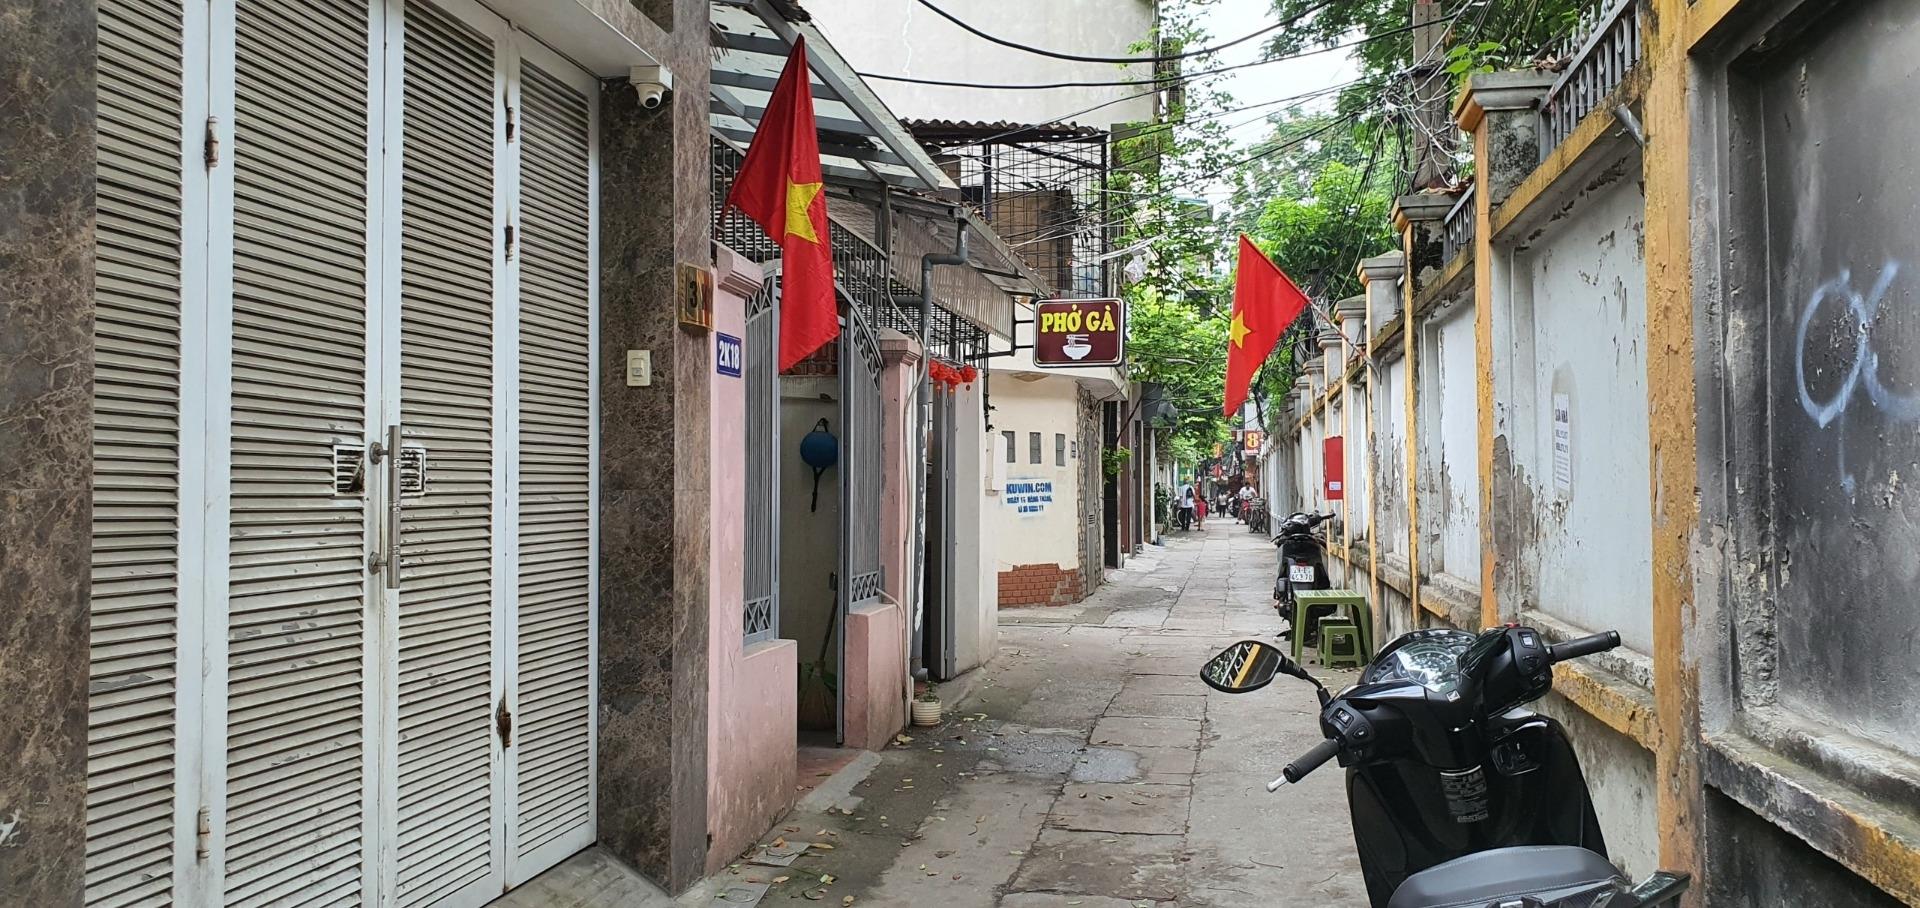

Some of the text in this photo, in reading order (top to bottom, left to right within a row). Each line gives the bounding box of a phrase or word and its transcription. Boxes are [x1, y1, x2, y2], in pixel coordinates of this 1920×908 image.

[1041, 304, 1116, 332] PHỞ GÀ
[719, 340, 740, 370] 2K18
[1006, 482, 1052, 494] KUWIN.COM
